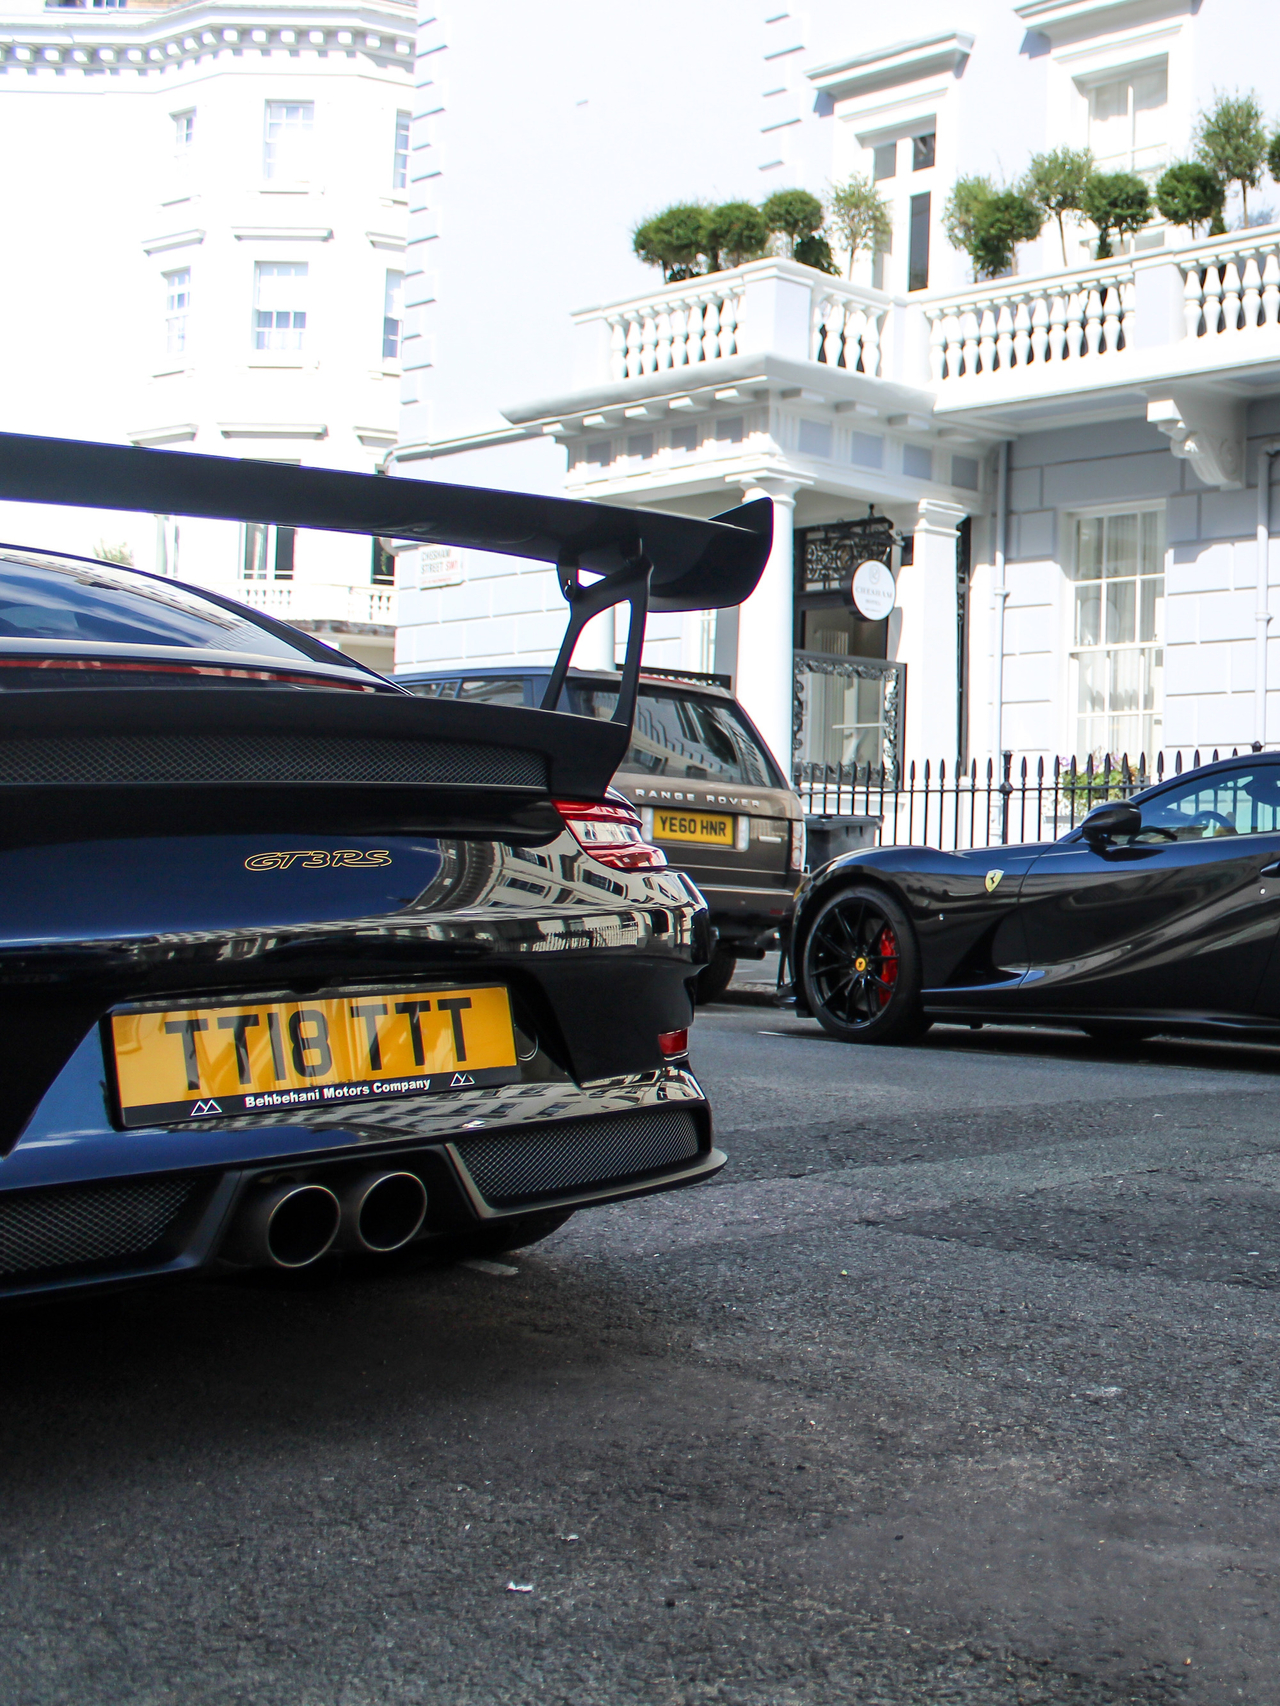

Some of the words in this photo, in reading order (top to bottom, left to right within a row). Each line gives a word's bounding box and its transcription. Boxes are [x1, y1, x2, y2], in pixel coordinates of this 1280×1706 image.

[421, 561, 443, 575] STREET
[635, 788, 695, 802] RANGE
[706, 795, 760, 807] ROVER
[659, 816, 697, 834] YE60
[701, 819, 727, 837] HNR
[164, 1008, 332, 1092] TT18
[351, 997, 473, 1072] TTT
[244, 1089, 320, 1109] Behbehani
[323, 1084, 370, 1100] Motors
[372, 1077, 431, 1094] Company
